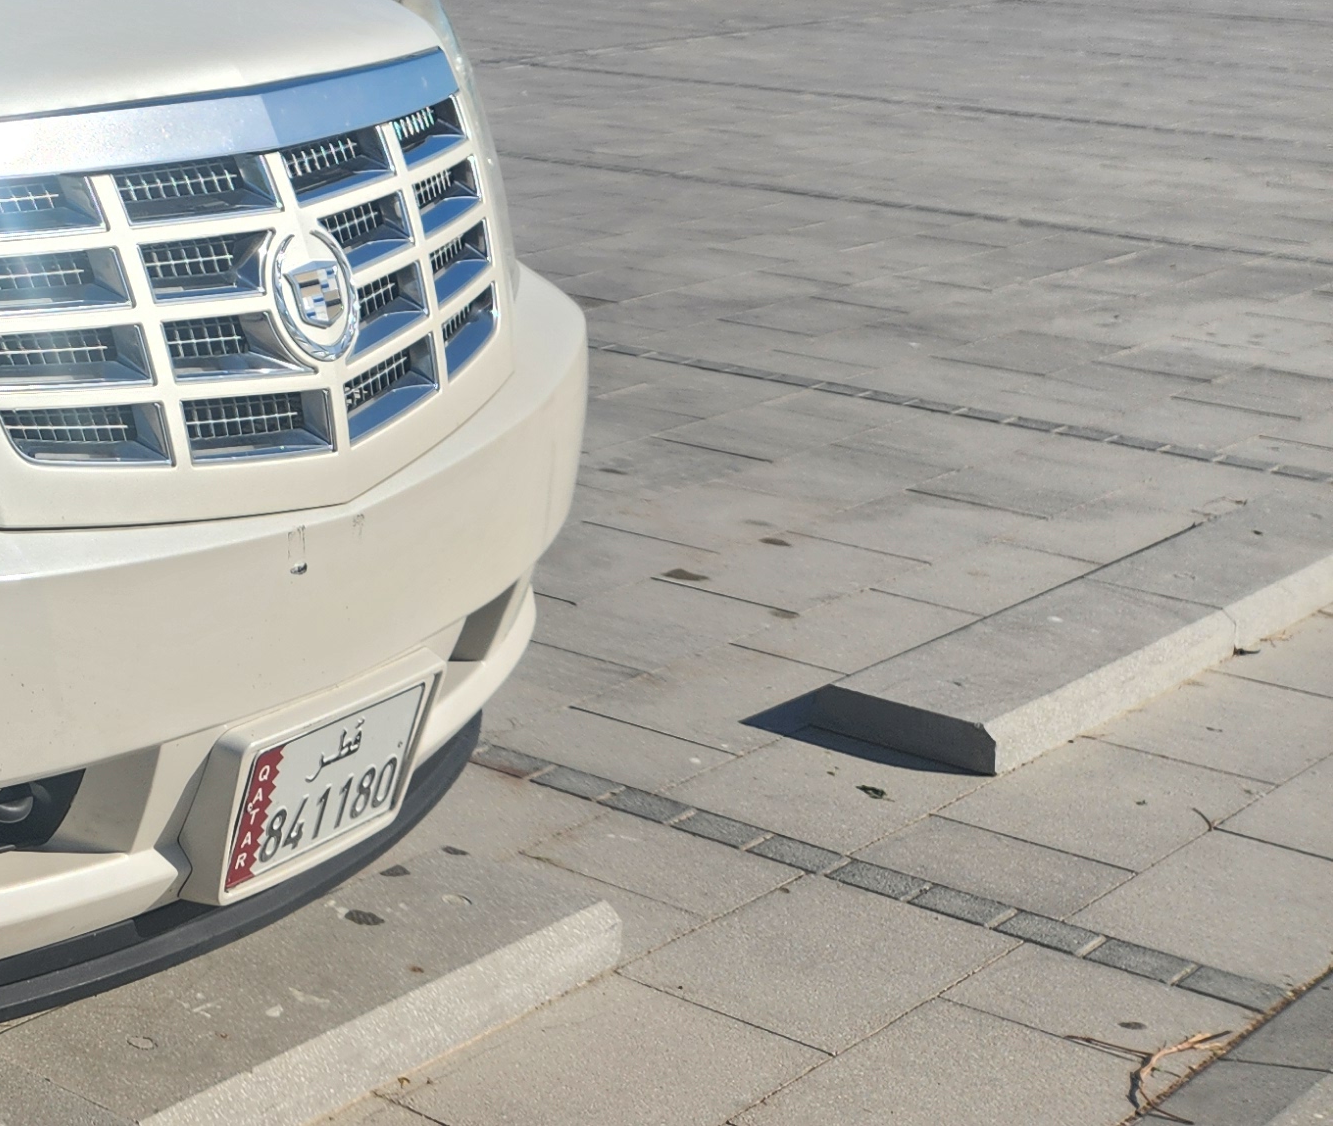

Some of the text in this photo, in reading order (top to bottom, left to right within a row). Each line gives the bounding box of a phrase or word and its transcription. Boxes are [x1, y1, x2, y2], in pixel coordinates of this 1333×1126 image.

[304, 716, 366, 783] قطر
[234, 764, 271, 870] QATAR
[258, 753, 398, 863] 841180
